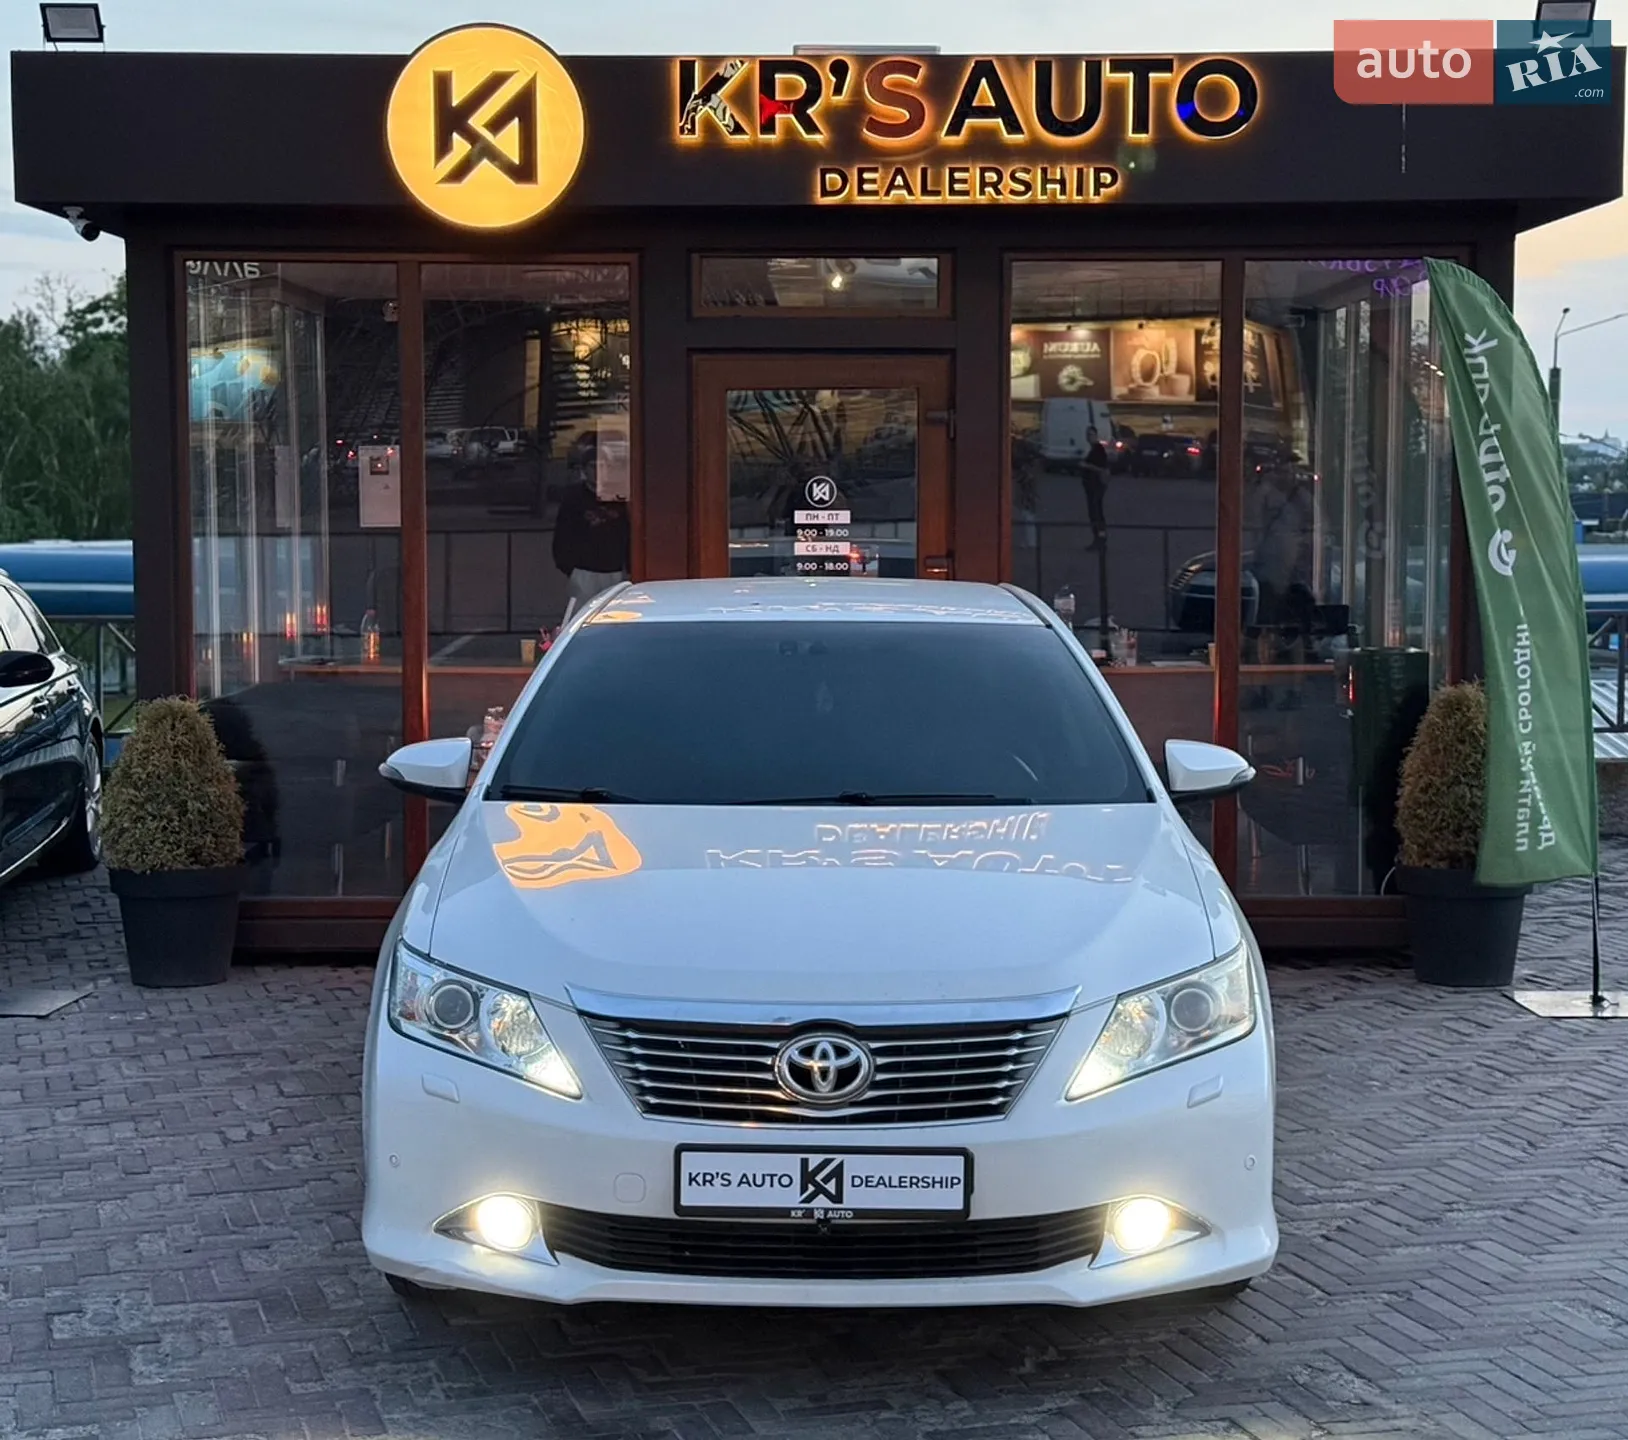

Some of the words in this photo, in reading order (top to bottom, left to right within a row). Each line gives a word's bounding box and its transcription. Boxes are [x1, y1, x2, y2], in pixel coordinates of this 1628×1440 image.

[679, 58, 926, 140] KR'S
[942, 58, 1259, 141] AUTO
[818, 166, 1121, 200] DEALERSHIP
[805, 512, 819, 521] ПН
[827, 512, 840, 521] ПТ
[805, 544, 818, 553] СБ
[825, 544, 840, 553] НД
[687, 1171, 732, 1188] KR'S
[736, 1173, 794, 1189] AUTO
[850, 1175, 962, 1189] DEALERSHIP
[826, 1210, 854, 1219] AUTO
